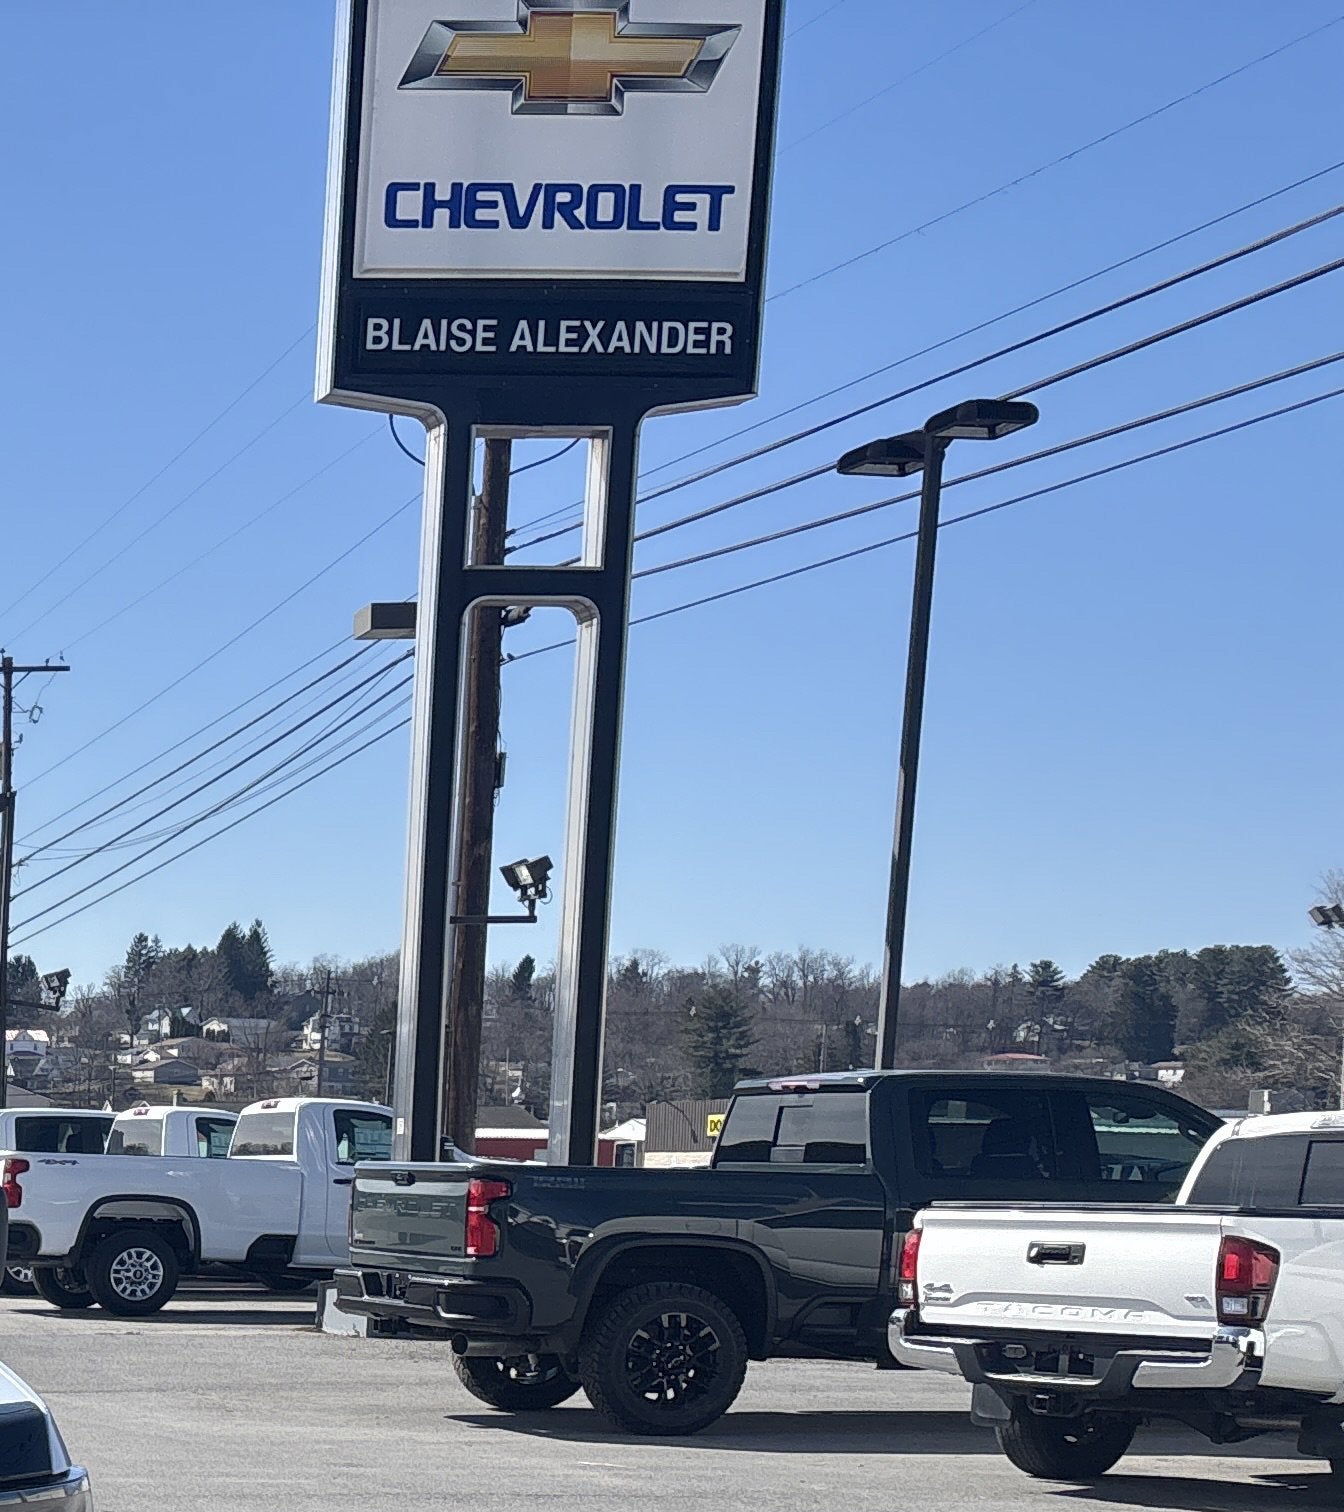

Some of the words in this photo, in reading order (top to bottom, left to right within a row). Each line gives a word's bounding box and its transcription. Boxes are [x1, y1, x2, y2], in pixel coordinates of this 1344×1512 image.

[384, 181, 736, 232] CHEVROLET
[365, 317, 497, 352] BLAISE
[509, 319, 734, 356] ALEXANDER
[975, 1301, 1146, 1323] TACOMA
